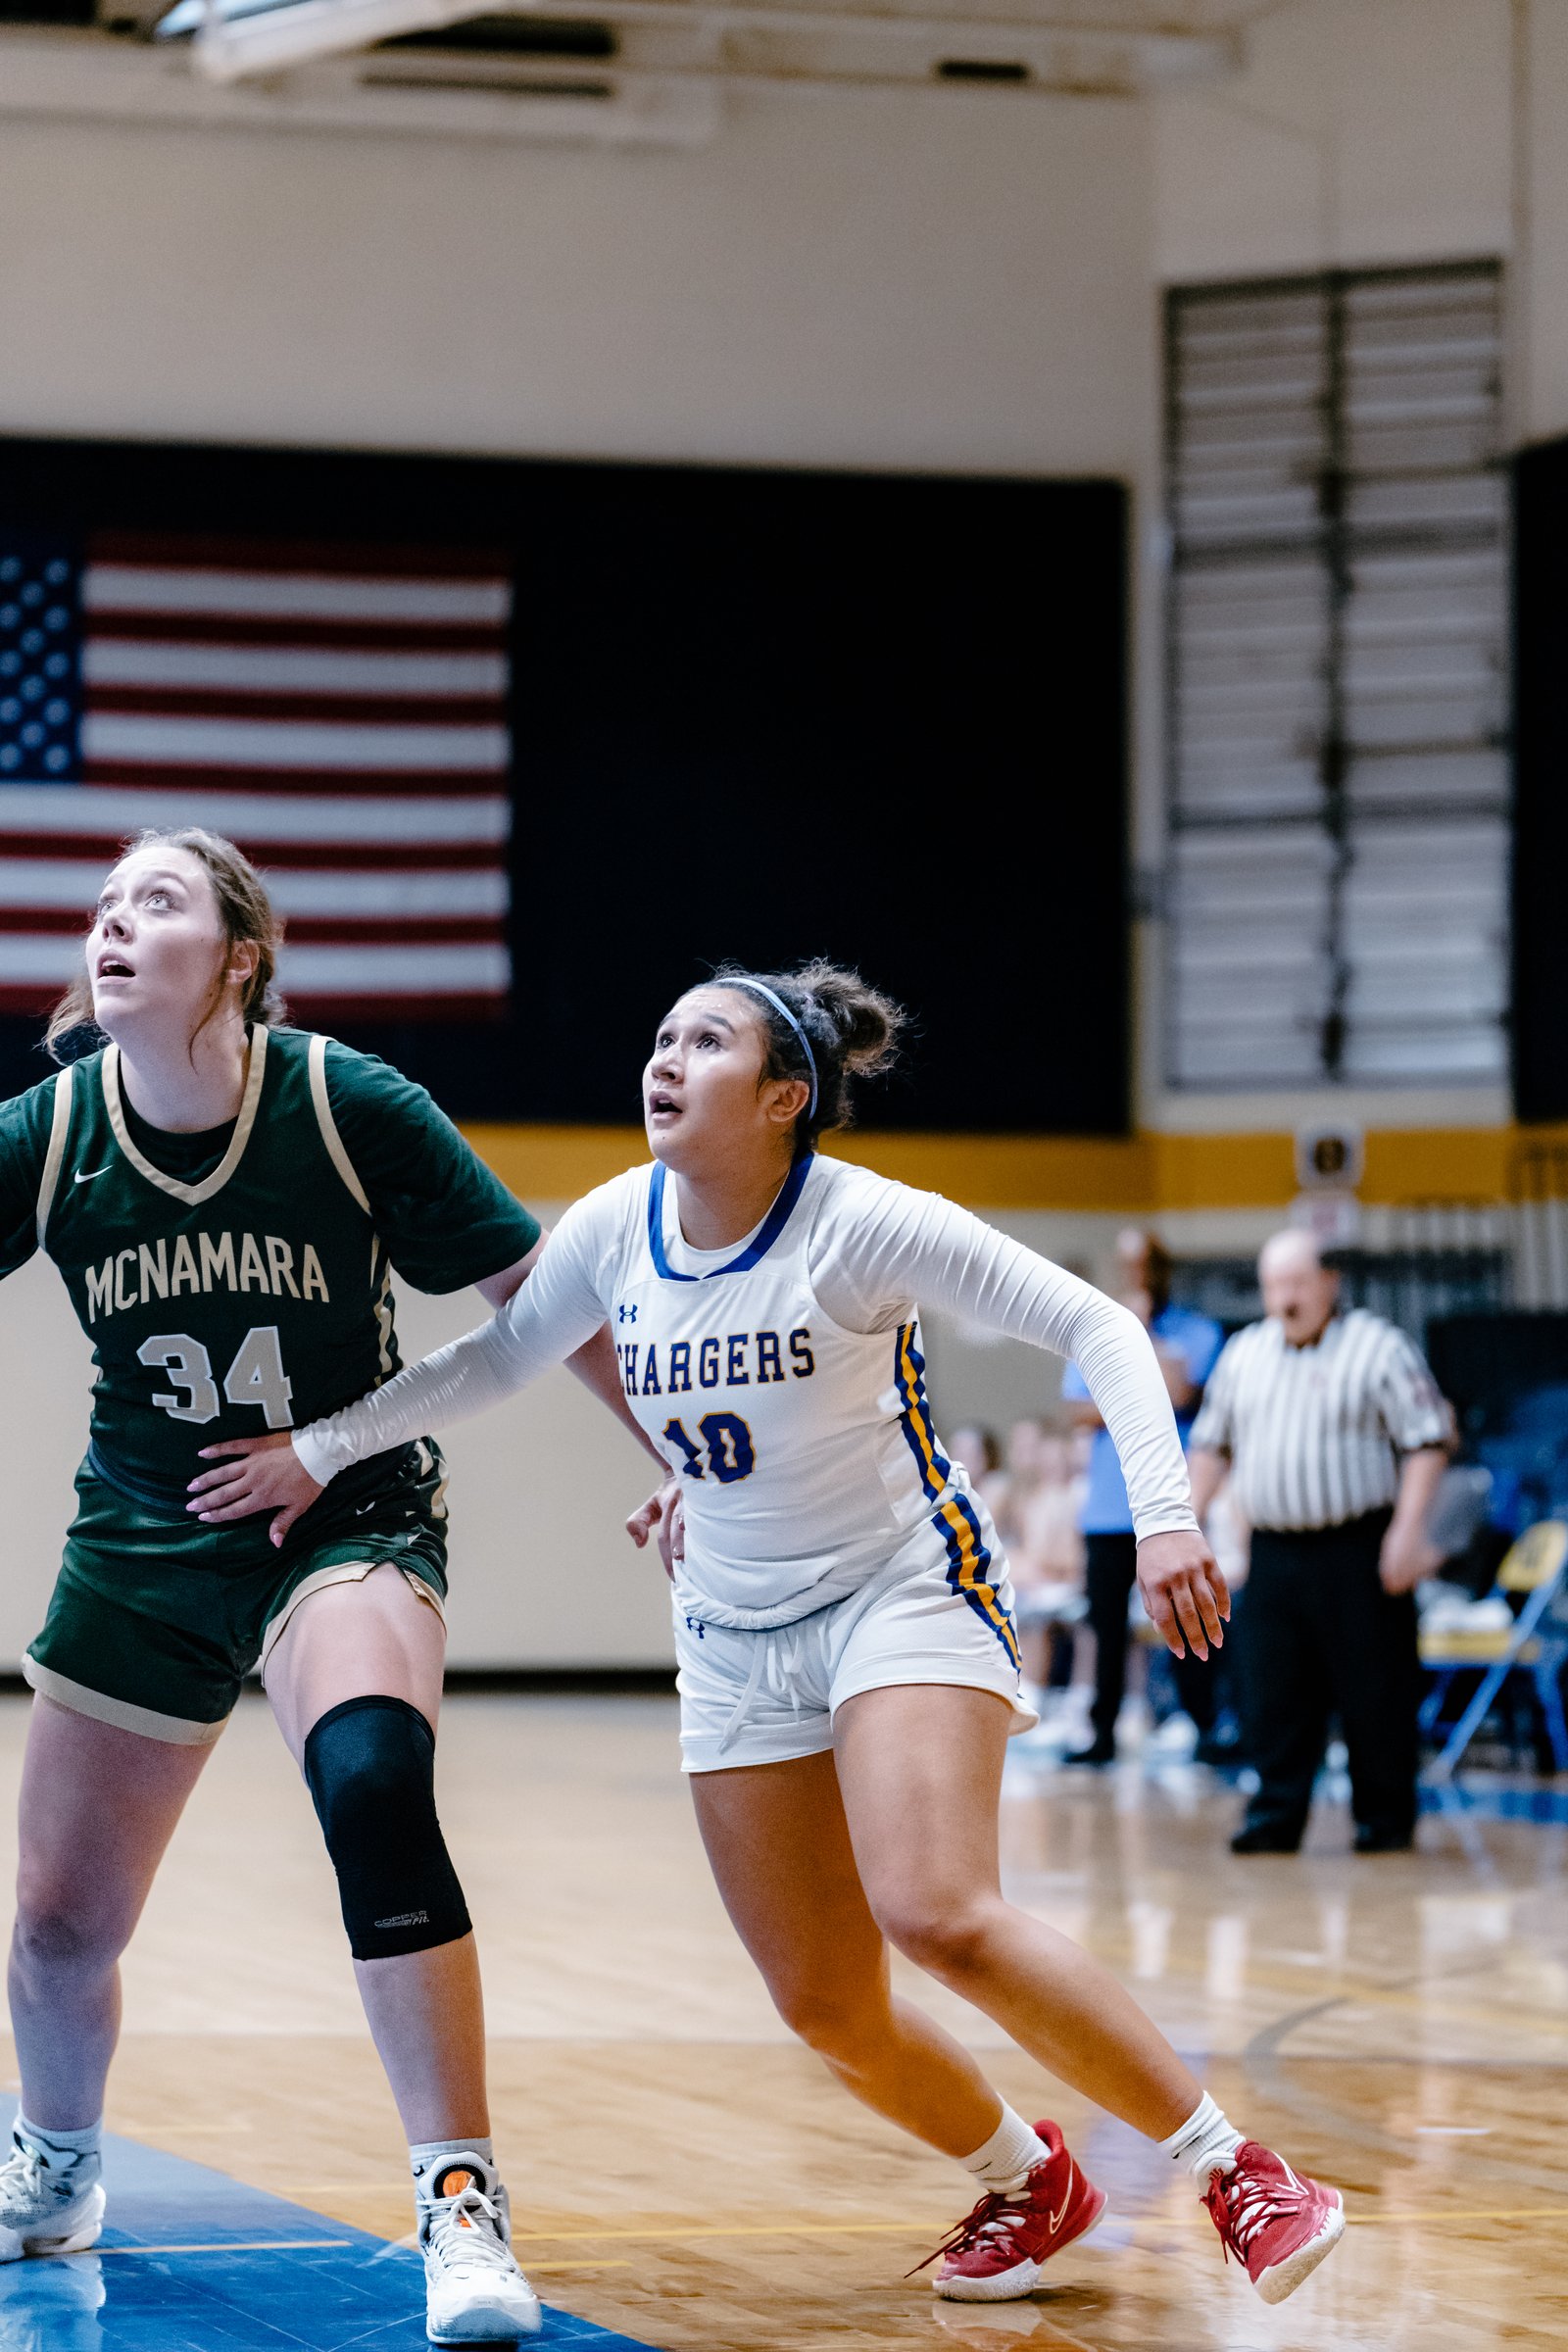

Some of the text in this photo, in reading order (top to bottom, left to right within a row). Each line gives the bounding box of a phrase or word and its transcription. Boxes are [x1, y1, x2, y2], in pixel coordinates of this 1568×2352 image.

[85, 1232, 329, 1323] MCNAMARA
[136, 1326, 294, 1429] 34
[617, 1327, 815, 1396] HARGERS
[662, 1411, 757, 1485] 10
[374, 1910, 427, 1927] COPPER
